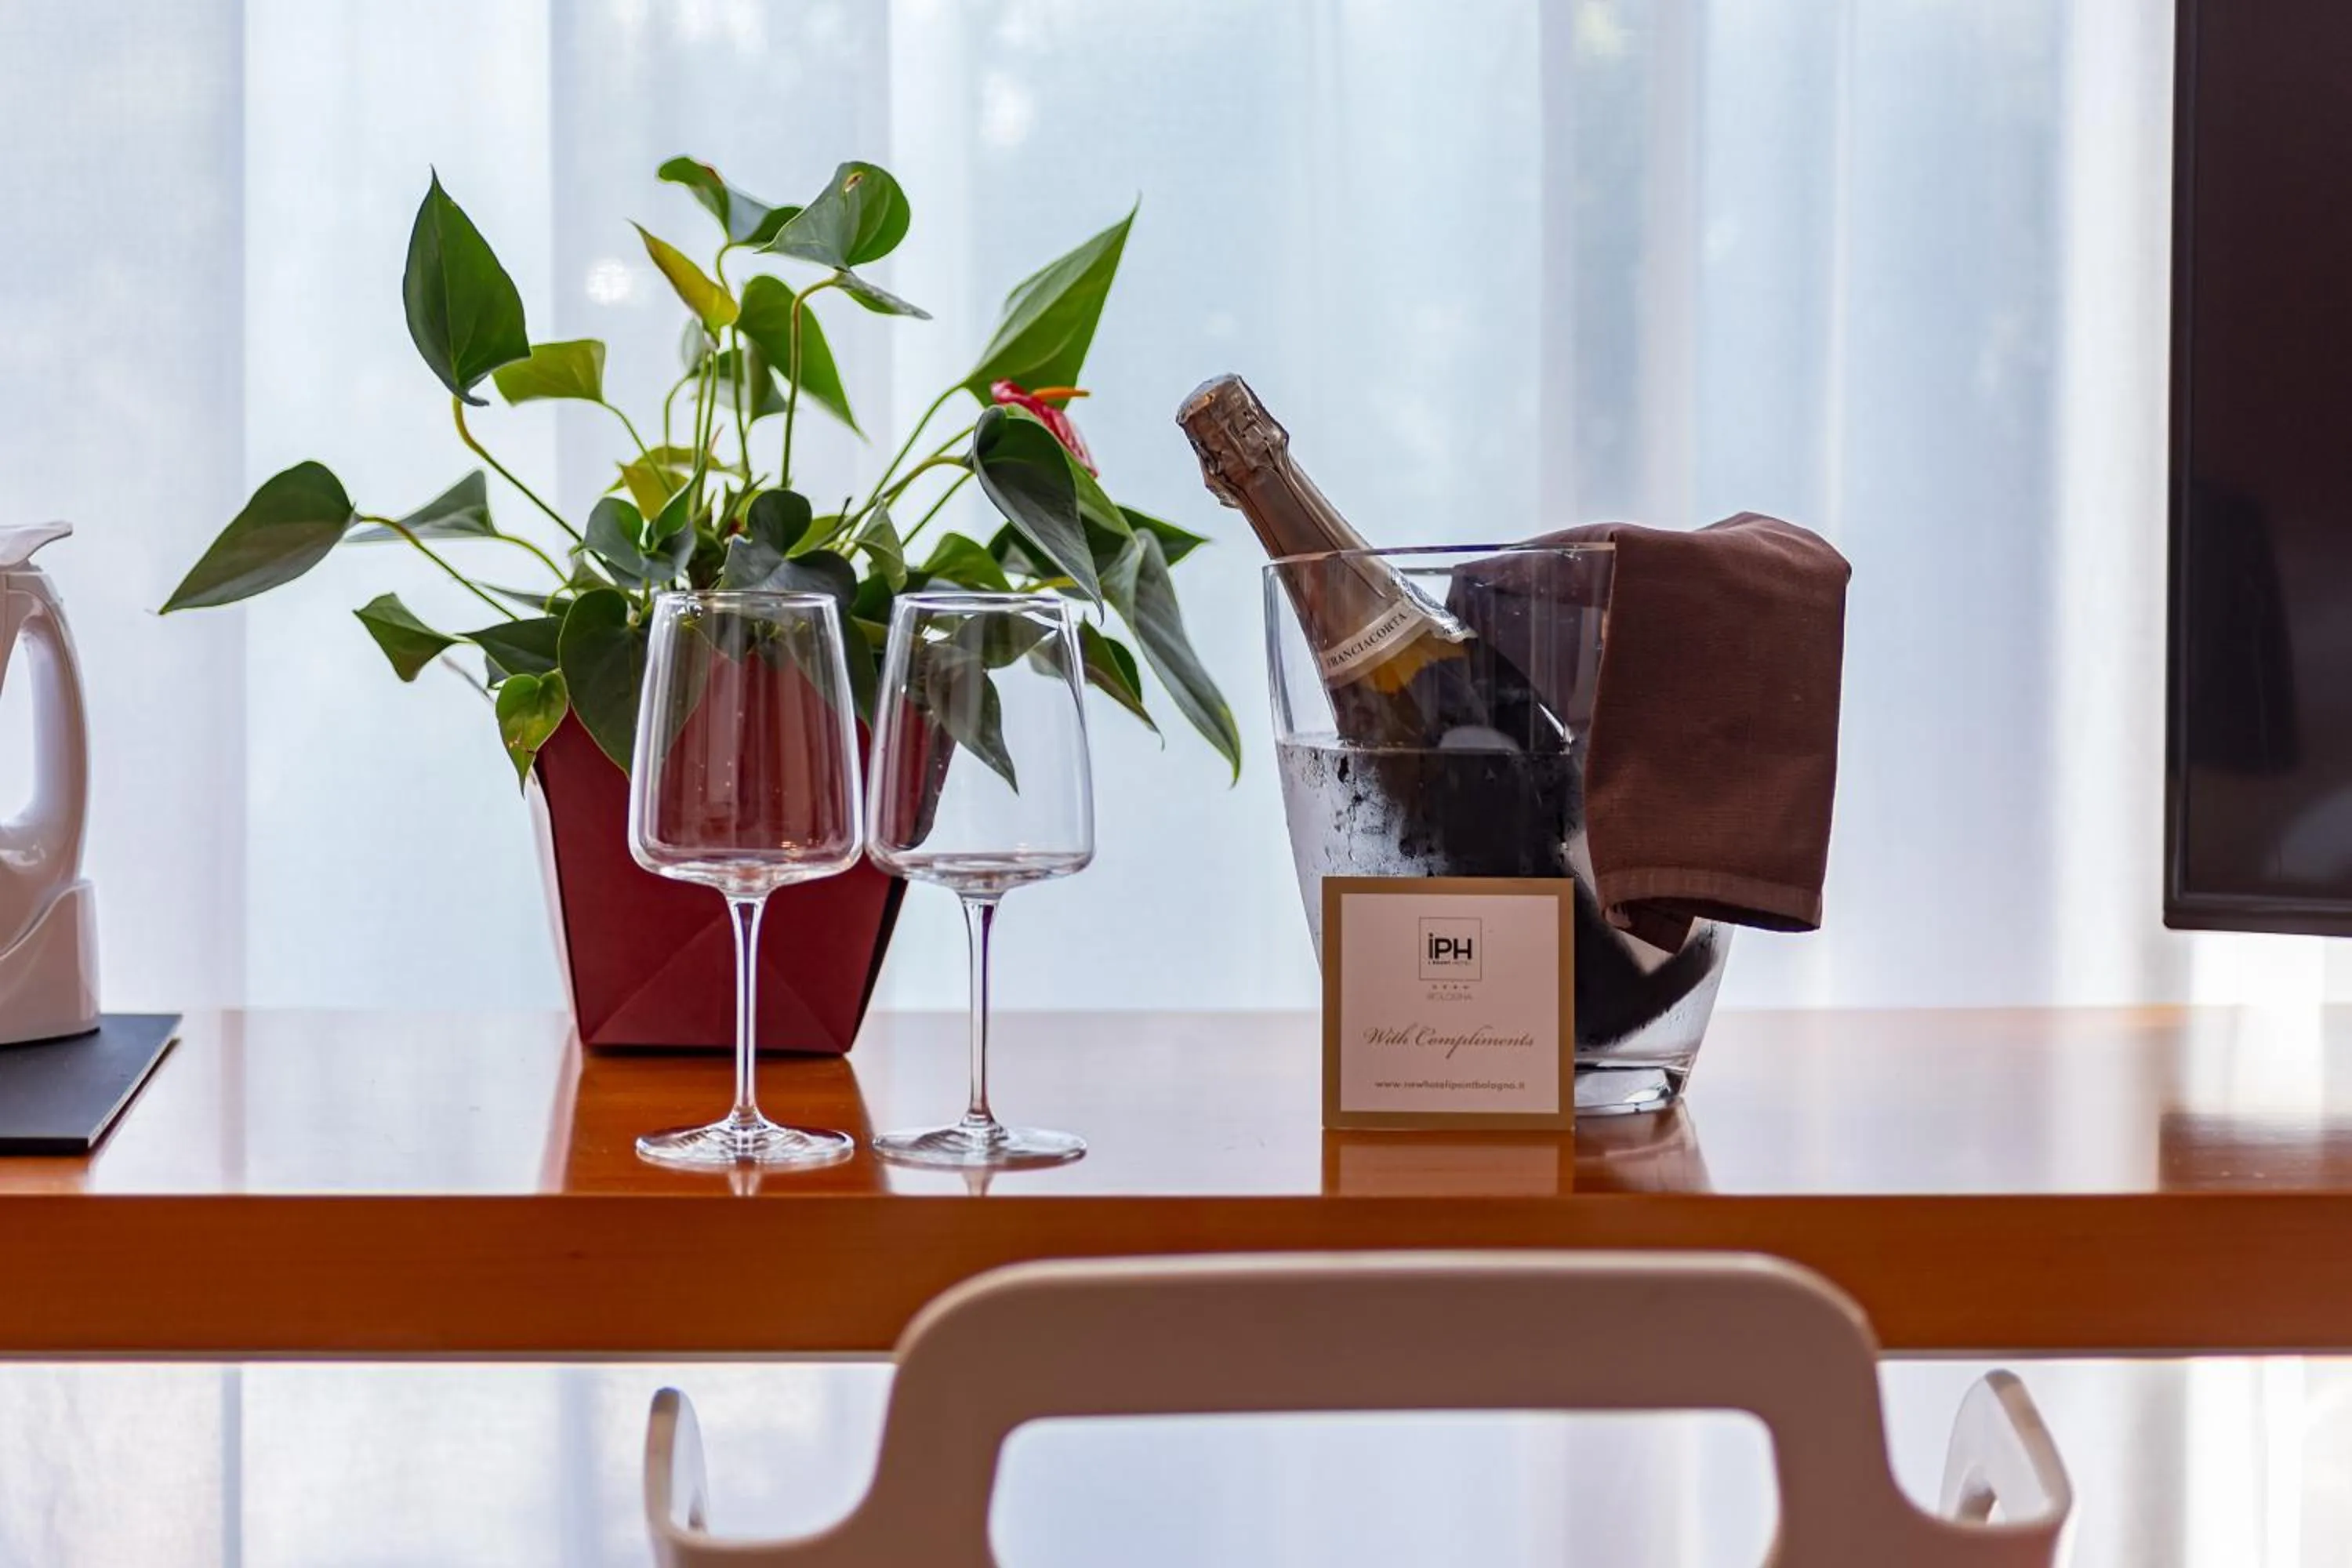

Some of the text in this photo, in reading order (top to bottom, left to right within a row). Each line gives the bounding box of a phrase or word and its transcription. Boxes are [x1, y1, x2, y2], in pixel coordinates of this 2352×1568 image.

[1428, 932, 1472, 960] iPH
[1363, 1022, 1534, 1059] With Compliments
